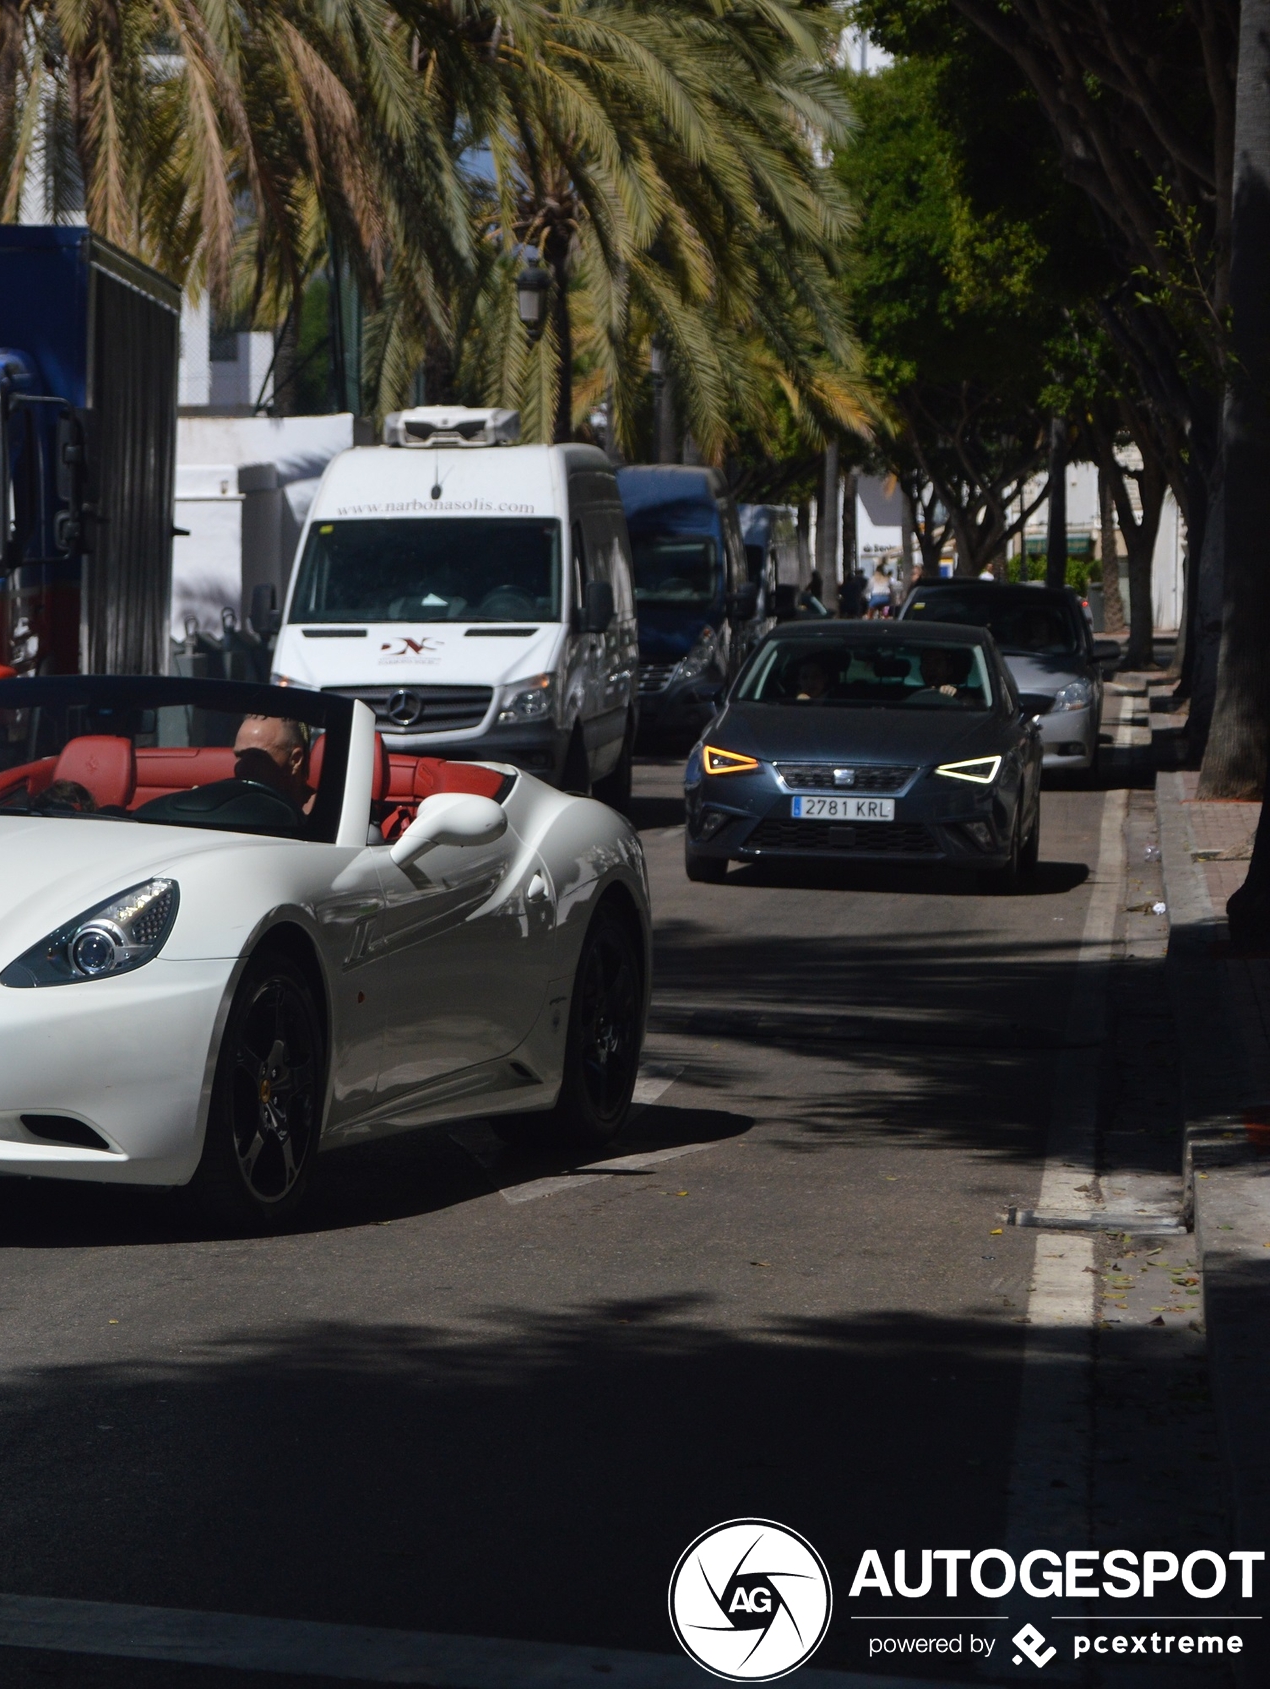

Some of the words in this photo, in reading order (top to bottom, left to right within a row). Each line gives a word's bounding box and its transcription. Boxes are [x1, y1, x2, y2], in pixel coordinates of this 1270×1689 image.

[337, 499, 535, 516] www.narbonasolis.com
[806, 799, 848, 816] 2781
[857, 801, 890, 817] KRL
